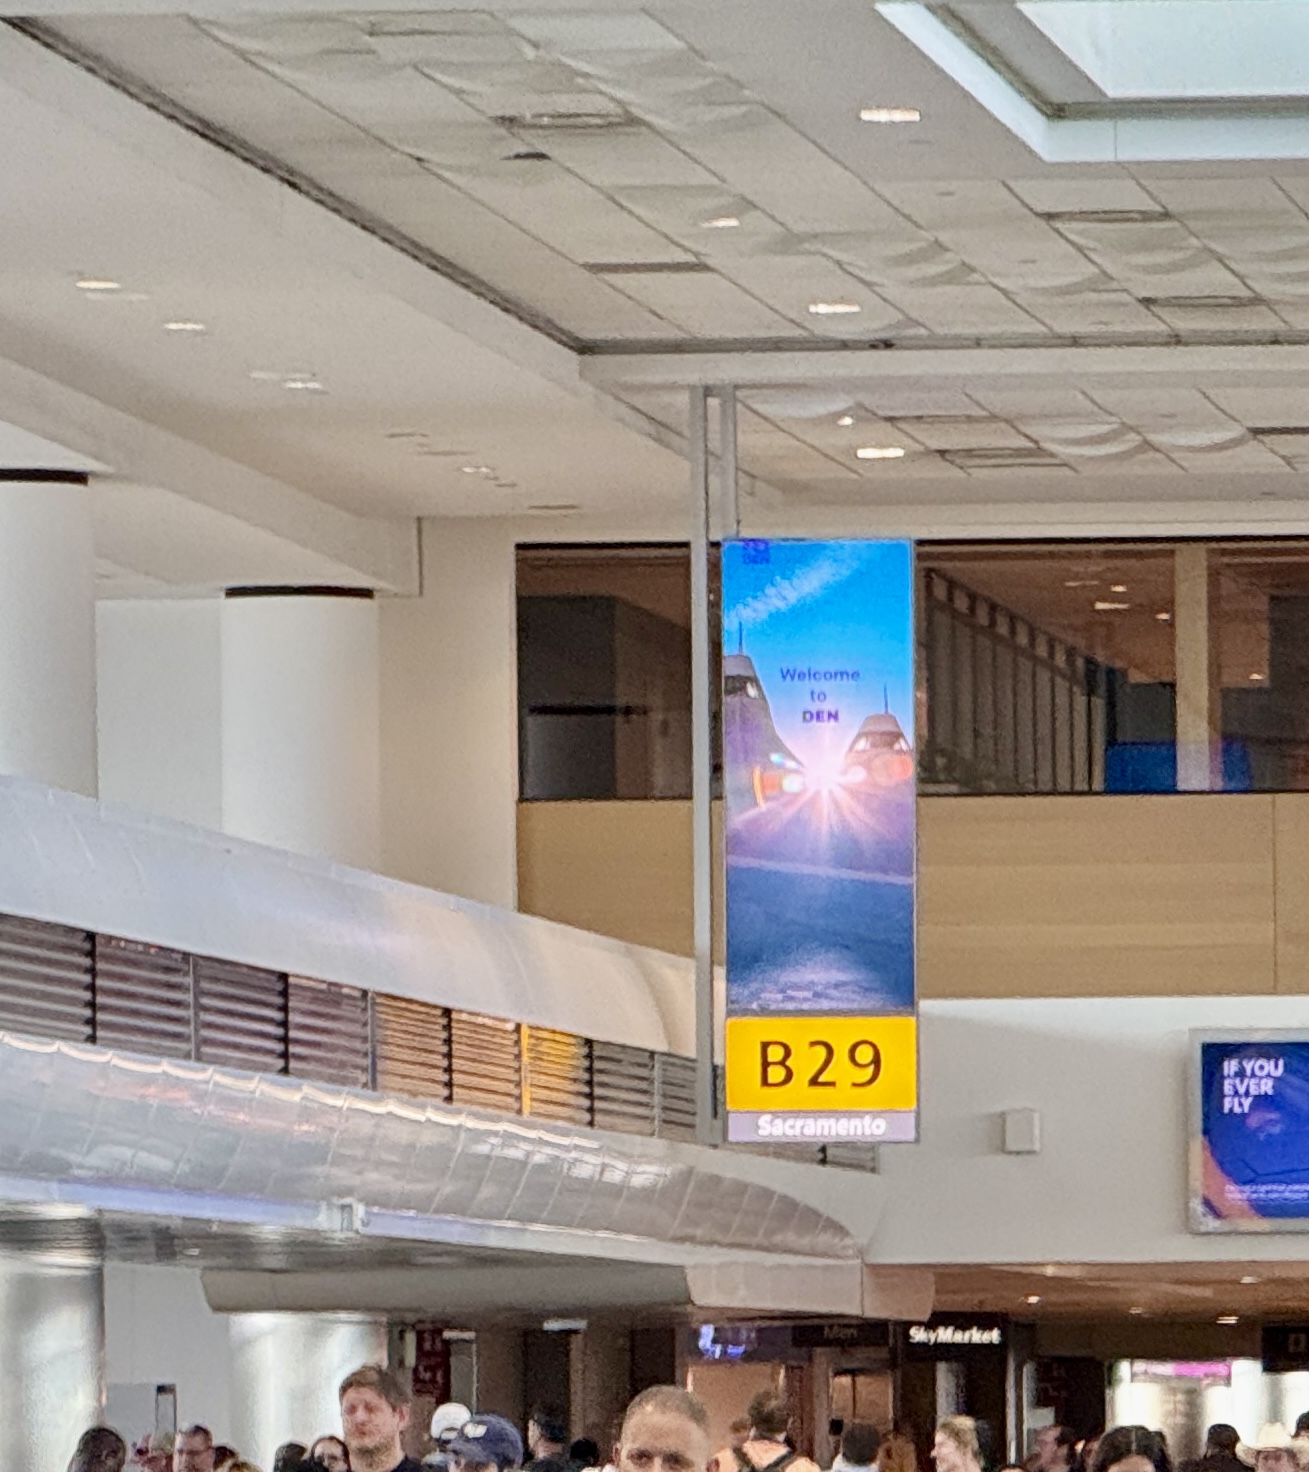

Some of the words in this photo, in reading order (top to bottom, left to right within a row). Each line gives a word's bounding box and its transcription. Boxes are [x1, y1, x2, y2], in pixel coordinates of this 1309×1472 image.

[780, 667, 860, 682] Welcome
[810, 689, 827, 703] to
[802, 710, 839, 723] DEN
[760, 1040, 882, 1088] B29
[1223, 1058, 1241, 1077] IF
[1242, 1058, 1284, 1077] YOU
[1223, 1077, 1274, 1095] EVER
[1223, 1096, 1253, 1114] FLY
[757, 1114, 886, 1136] Sacramento
[909, 1325, 1001, 1345] SkyMarket
